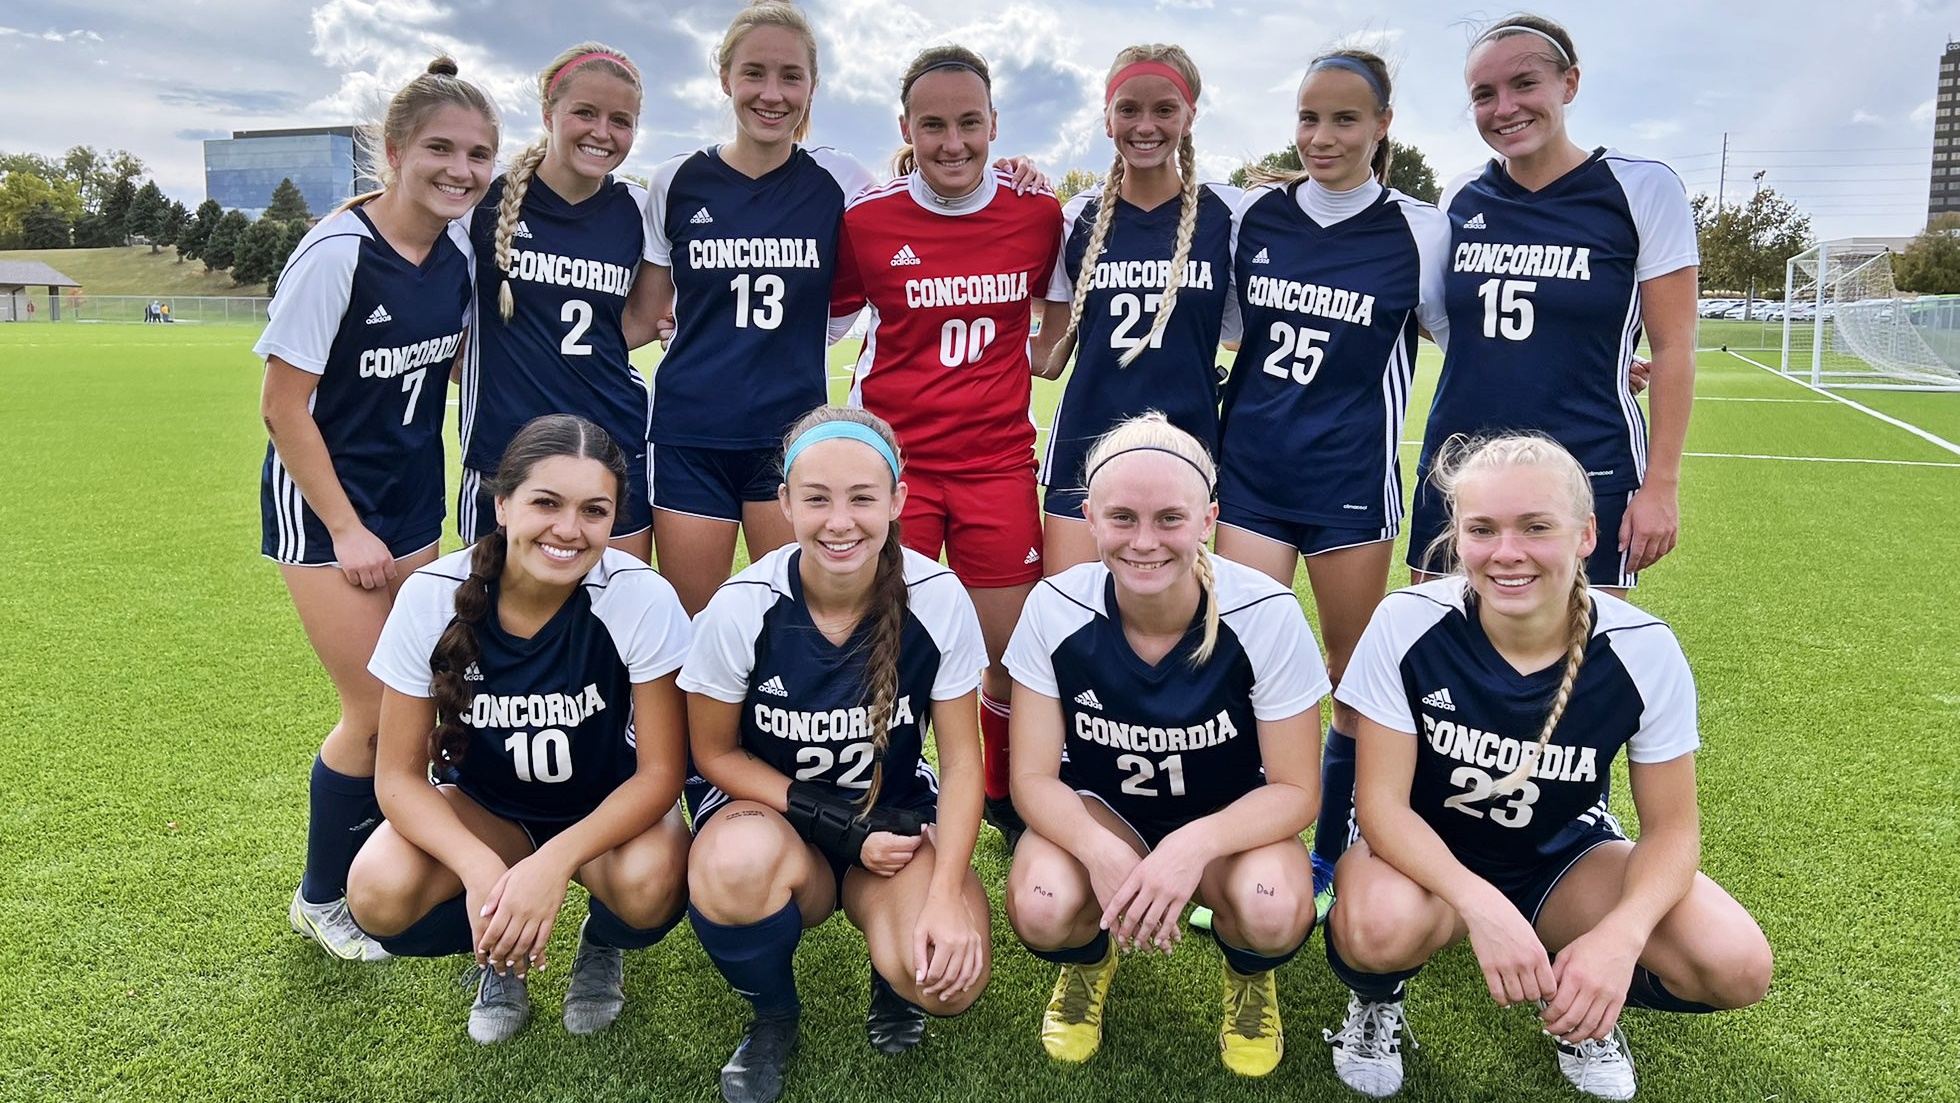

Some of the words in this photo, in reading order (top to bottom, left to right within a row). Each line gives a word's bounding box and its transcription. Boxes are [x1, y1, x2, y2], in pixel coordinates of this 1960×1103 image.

[689, 216, 714, 224] adidas
[1463, 222, 1487, 230] adidas
[688, 237, 820, 270] CONCORDIA
[890, 256, 921, 267] adidas
[1453, 242, 1591, 281] CONCORDIA
[730, 273, 785, 330] 13
[904, 271, 1029, 309] CONCORDIA
[1247, 274, 1375, 327] CONCORDIA
[1477, 278, 1538, 341] 15
[365, 314, 392, 325] adidas
[560, 299, 593, 355] 2
[1109, 292, 1178, 349] 27
[939, 317, 996, 368] 00
[1262, 320, 1331, 386] 25
[401, 366, 427, 426] 7
[757, 683, 789, 698] adidas
[1073, 696, 1104, 711] adidas
[1421, 696, 1456, 712] adidas
[754, 694, 914, 743] CONCORA
[1074, 708, 1239, 753] CONCORDIA
[504, 728, 574, 784] 10
[795, 741, 875, 790] 22
[1116, 753, 1186, 797] 21
[1443, 765, 1541, 829] 23
[1256, 883, 1275, 897] Dad
